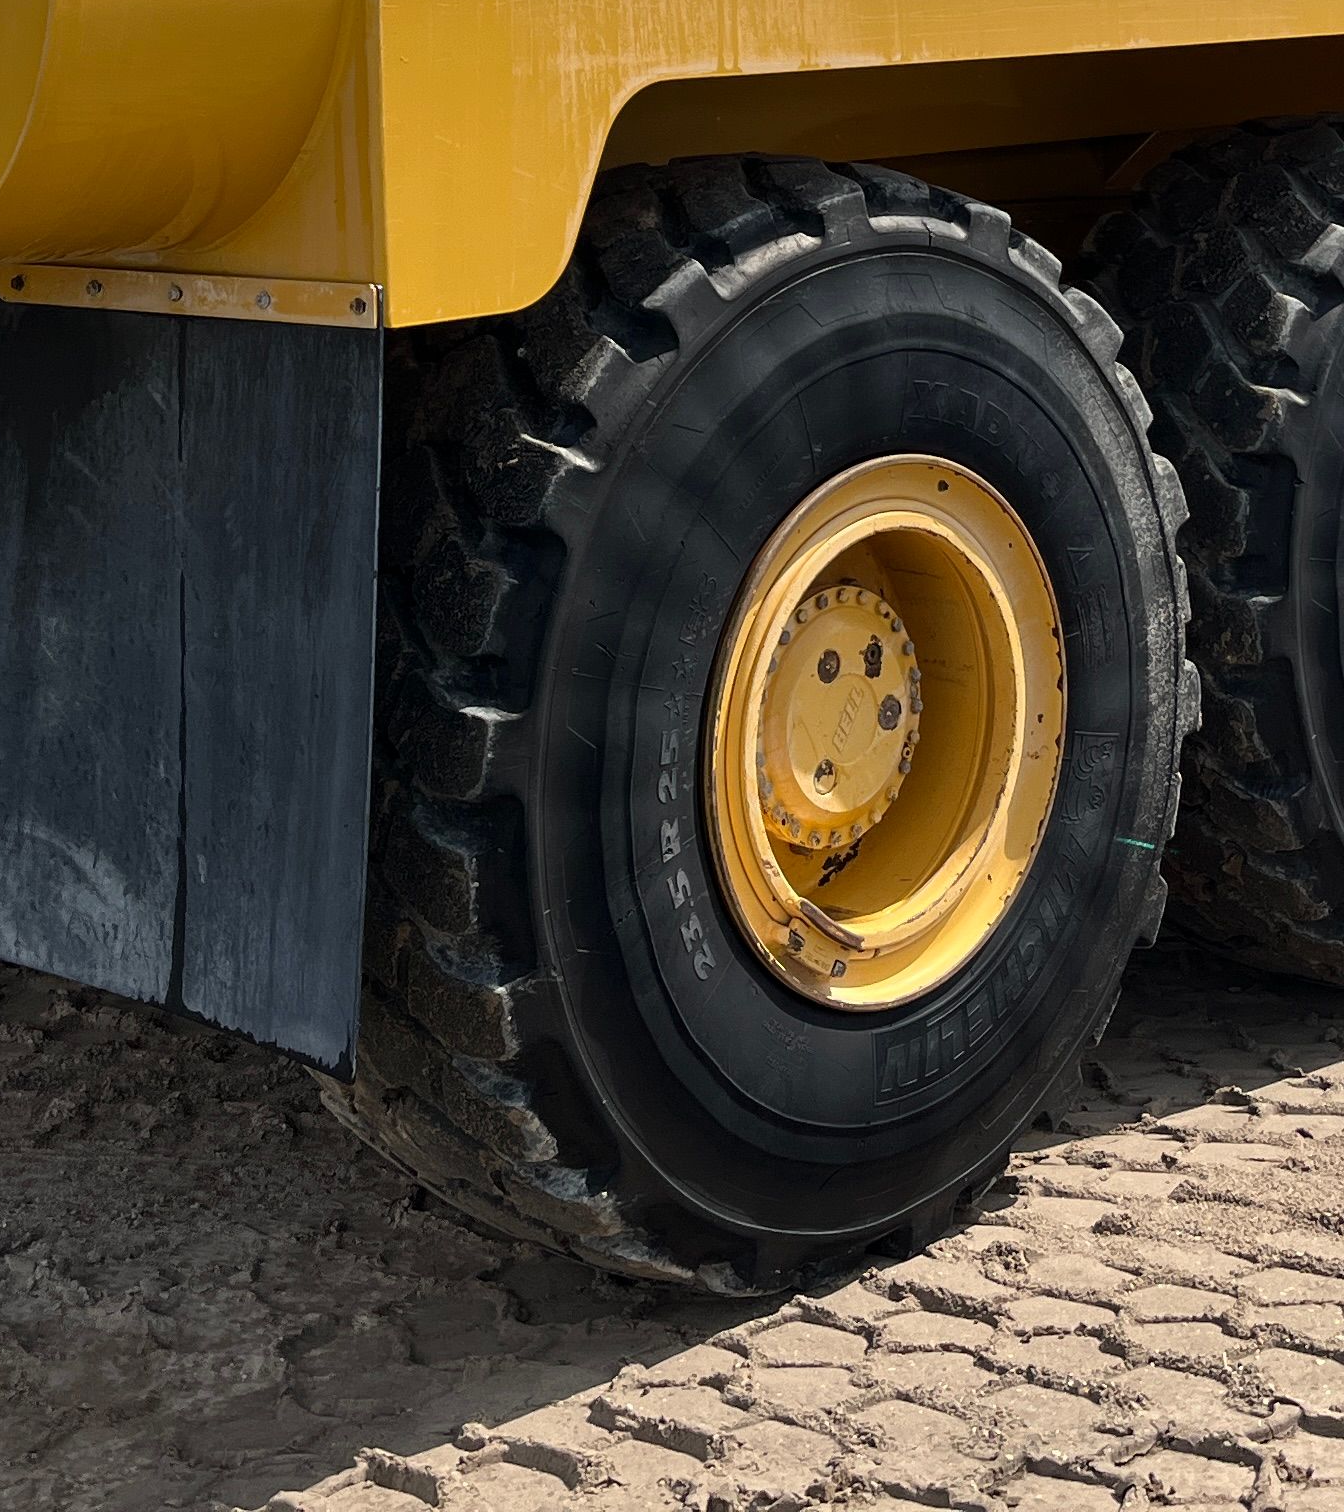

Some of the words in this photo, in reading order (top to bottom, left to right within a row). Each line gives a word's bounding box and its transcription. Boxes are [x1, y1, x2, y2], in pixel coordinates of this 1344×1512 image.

[657, 729, 681, 805] 25
[660, 817, 682, 864] R
[879, 828, 1092, 1094] MICHELIN
